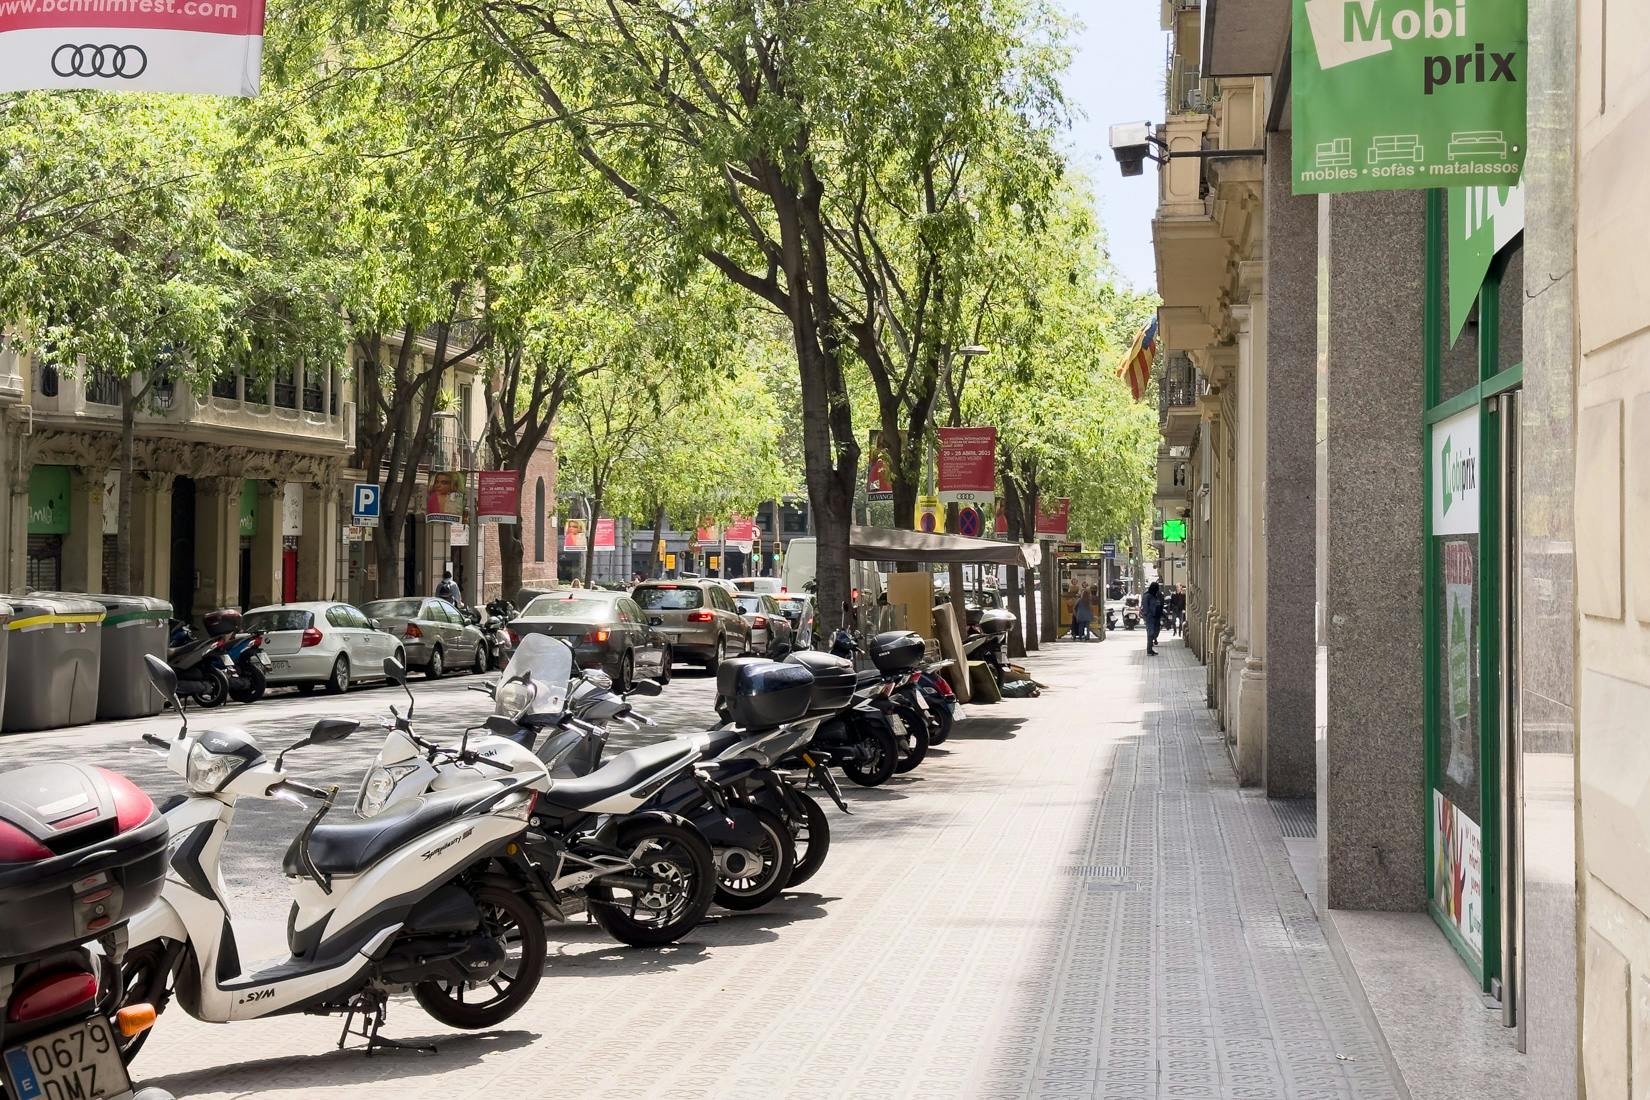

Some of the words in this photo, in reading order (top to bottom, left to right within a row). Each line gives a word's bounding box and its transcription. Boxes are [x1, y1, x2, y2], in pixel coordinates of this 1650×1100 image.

[1344, 0, 1466, 42] Mobi
[1424, 43, 1517, 95] prix
[1301, 167, 1358, 181] mobles
[1371, 163, 1415, 178] sofàs
[1429, 160, 1519, 175] matalassos
[359, 488, 375, 512] P
[246, 988, 275, 1002] SYM
[32, 1024, 110, 1076] 0679
[22, 1078, 33, 1091] E
[43, 1063, 105, 1100] DMZ
